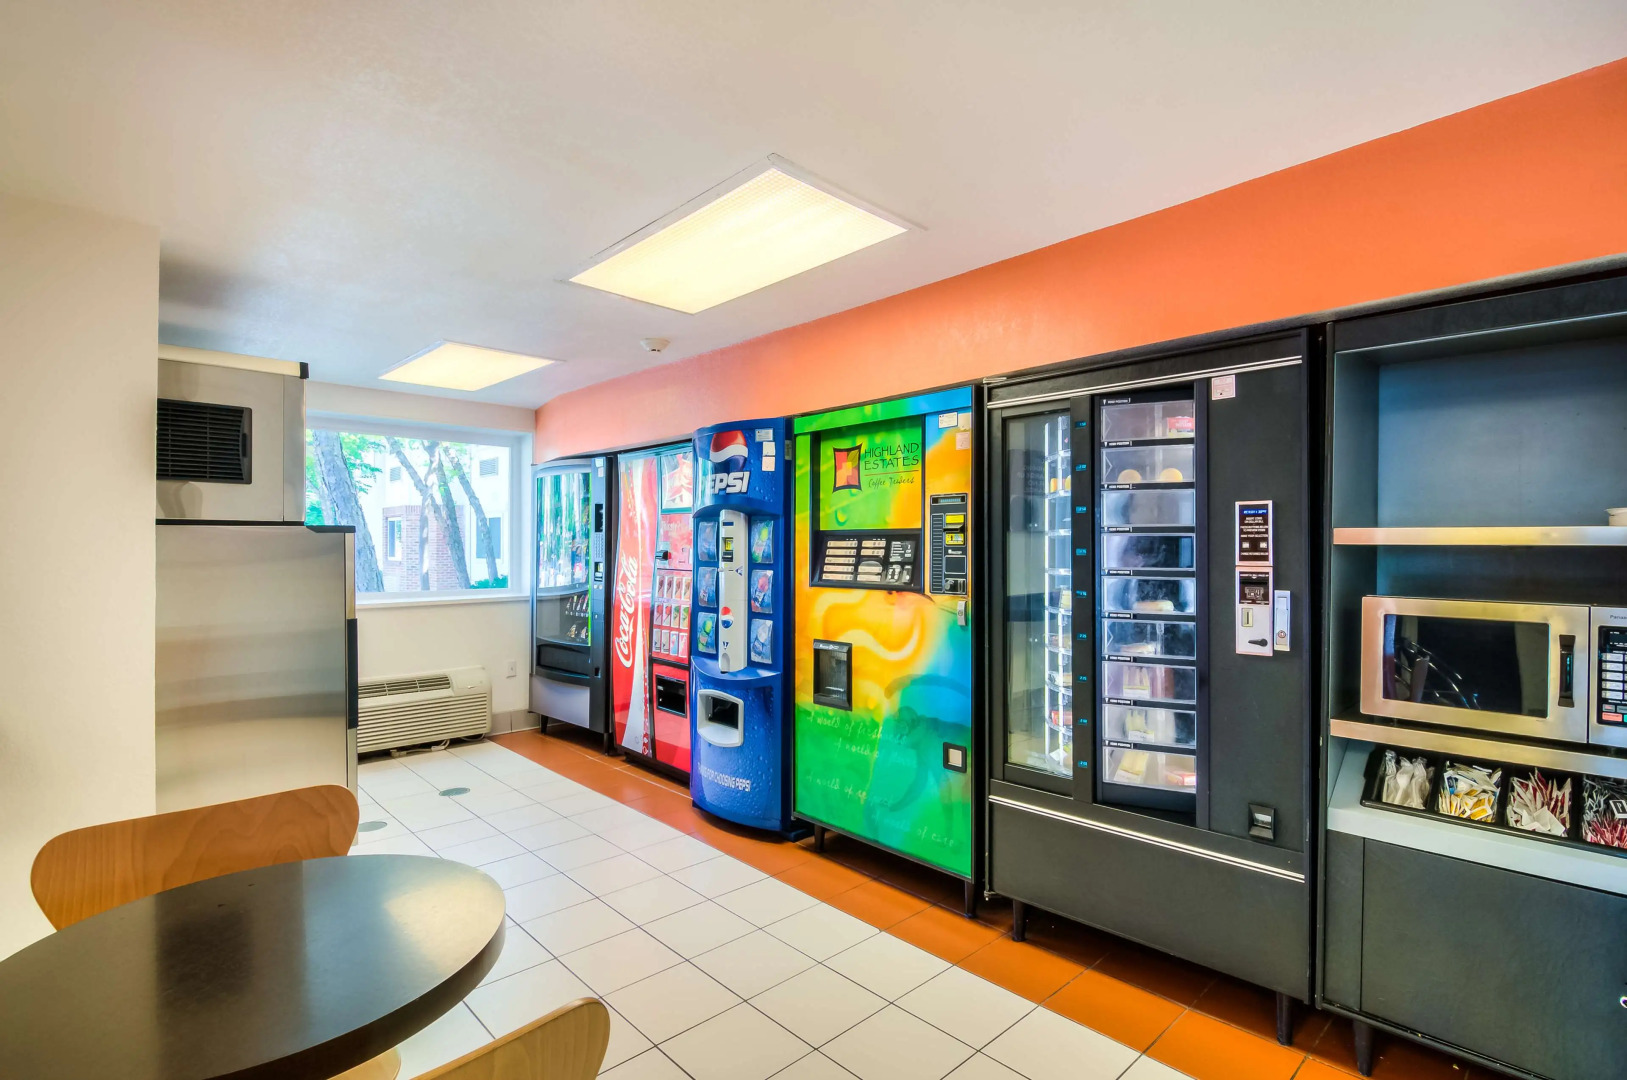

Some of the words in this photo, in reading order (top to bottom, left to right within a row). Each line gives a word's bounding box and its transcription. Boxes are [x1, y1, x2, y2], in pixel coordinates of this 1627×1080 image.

[864, 443, 920, 459] HIGHLAND
[864, 455, 920, 471] ESTATES
[868, 478, 886, 490] Coffee
